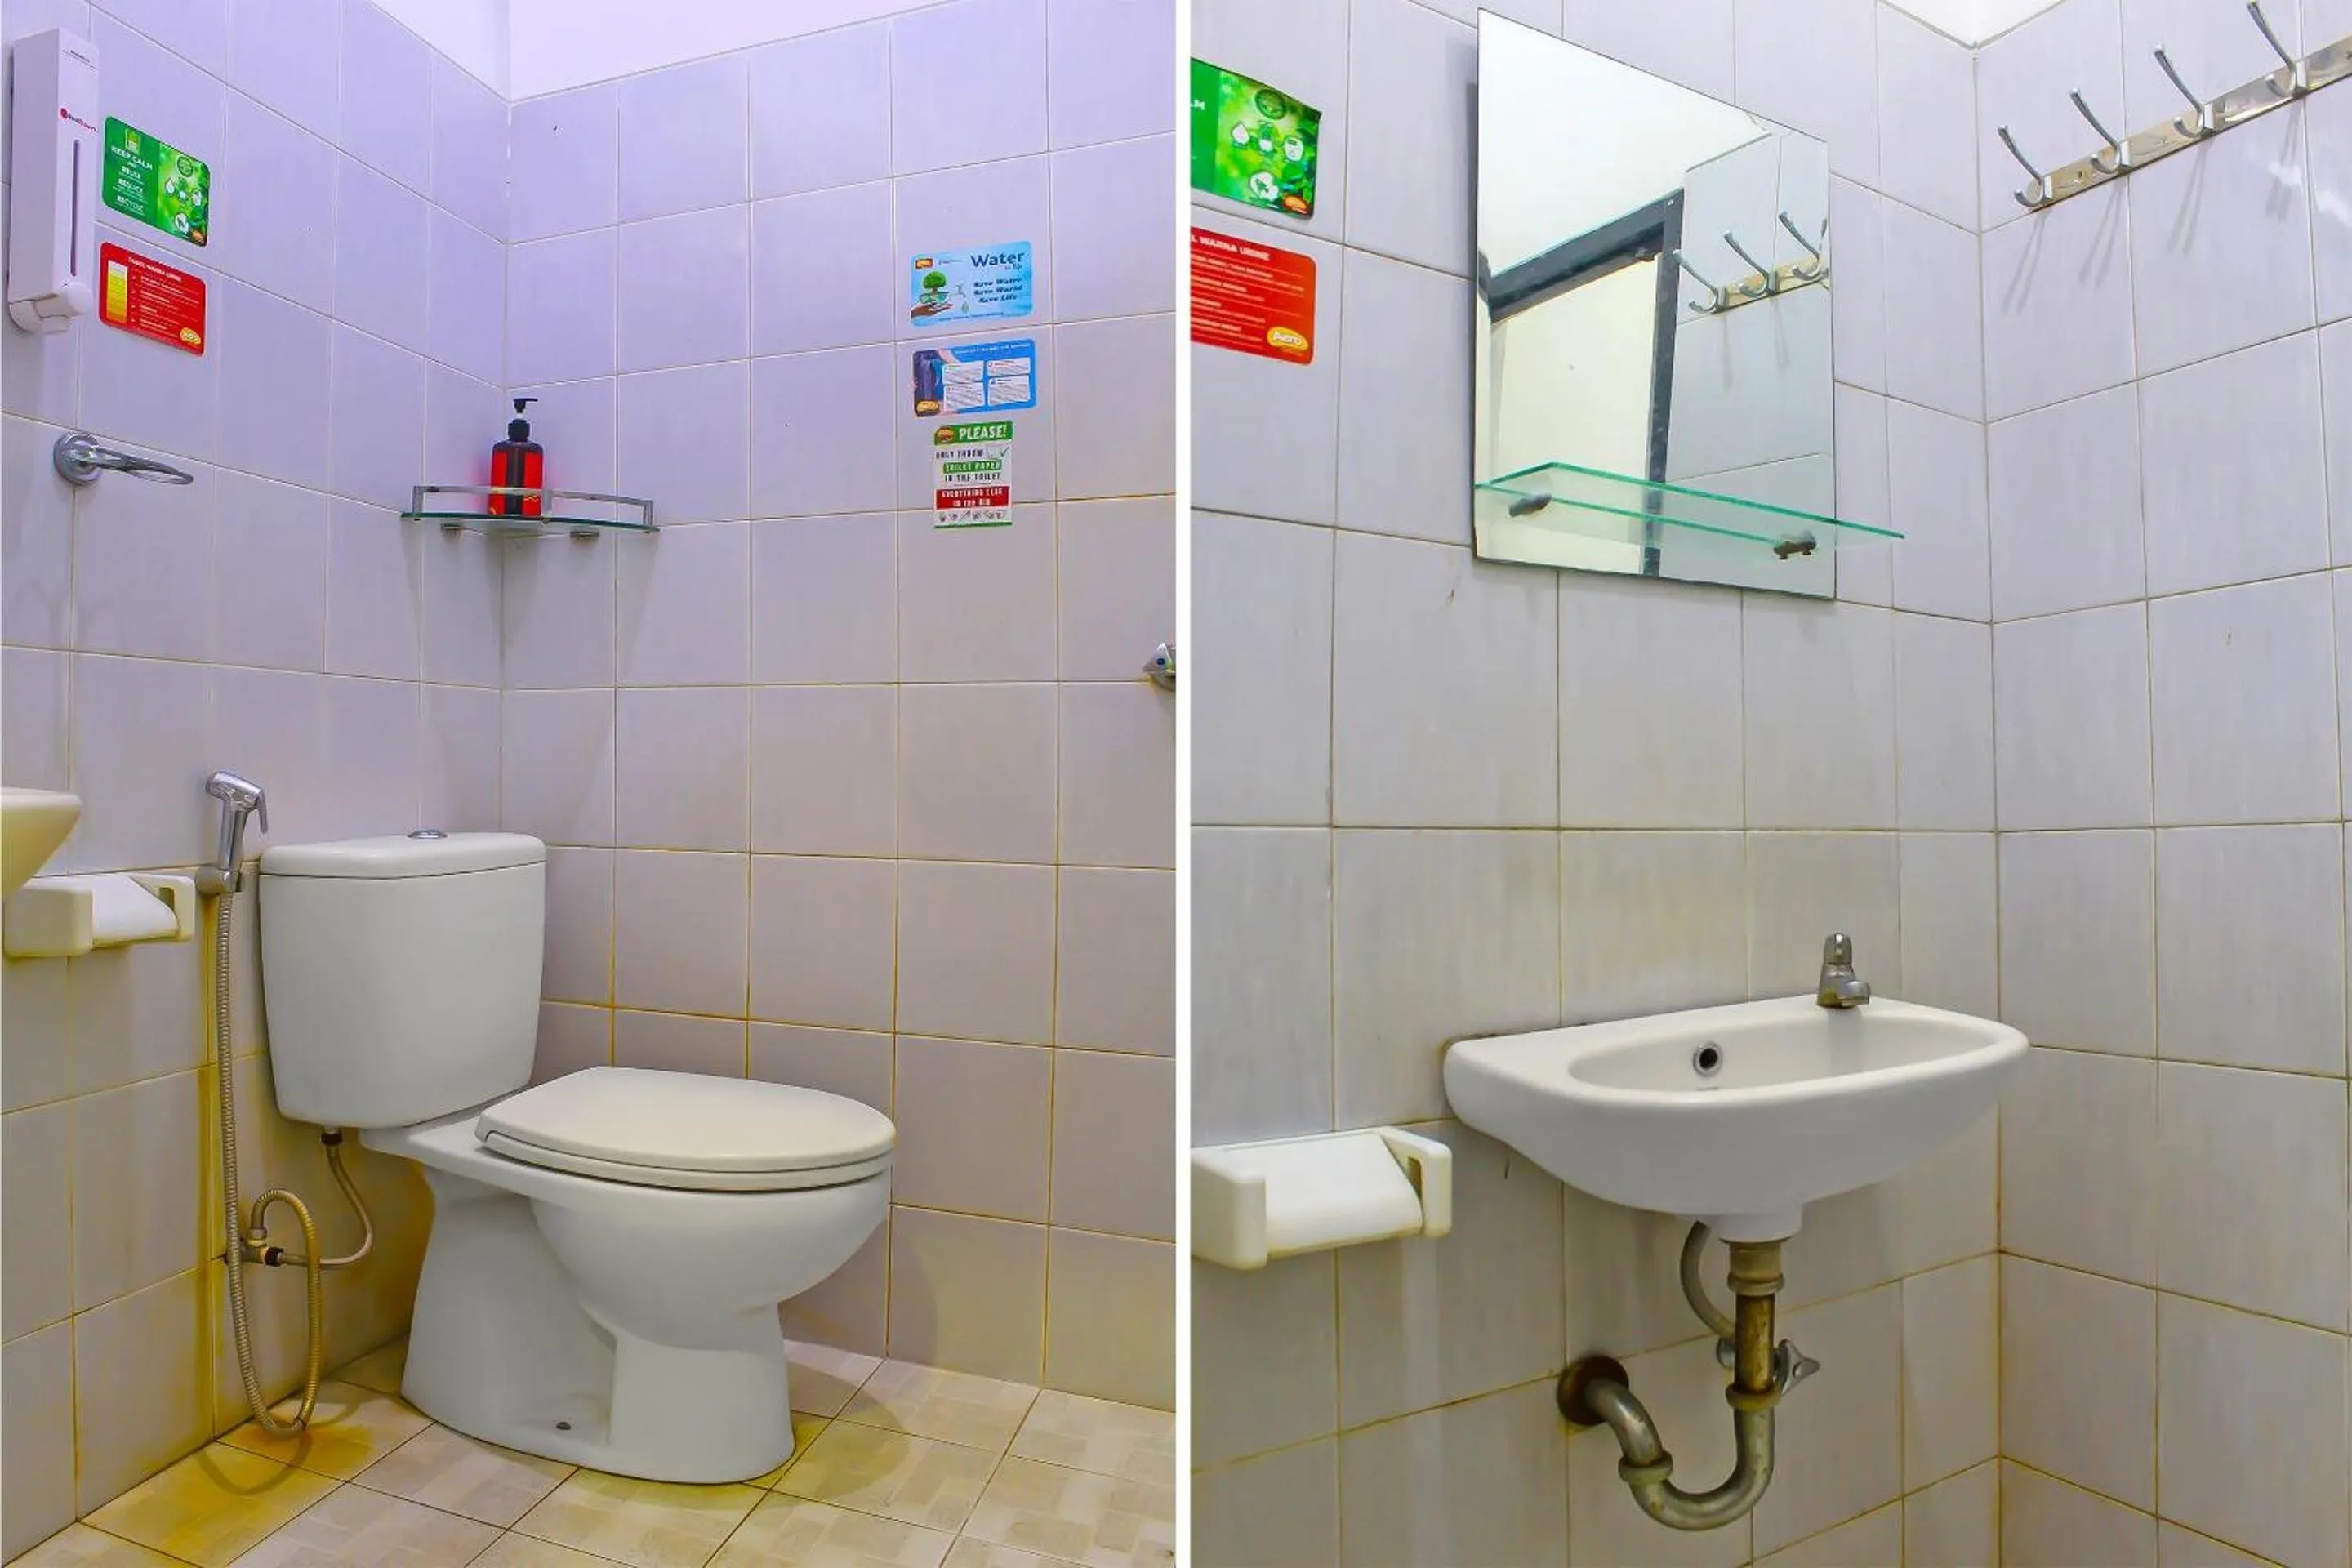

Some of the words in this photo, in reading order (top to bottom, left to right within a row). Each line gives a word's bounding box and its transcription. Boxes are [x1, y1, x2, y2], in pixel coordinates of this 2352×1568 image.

[131, 155, 153, 170] CALM
[970, 252, 1026, 268] Water
[959, 424, 1008, 440] PLEASE!
[957, 448, 984, 458] THROW
[956, 474, 970, 482] THE
[974, 471, 1001, 481] TOILET
